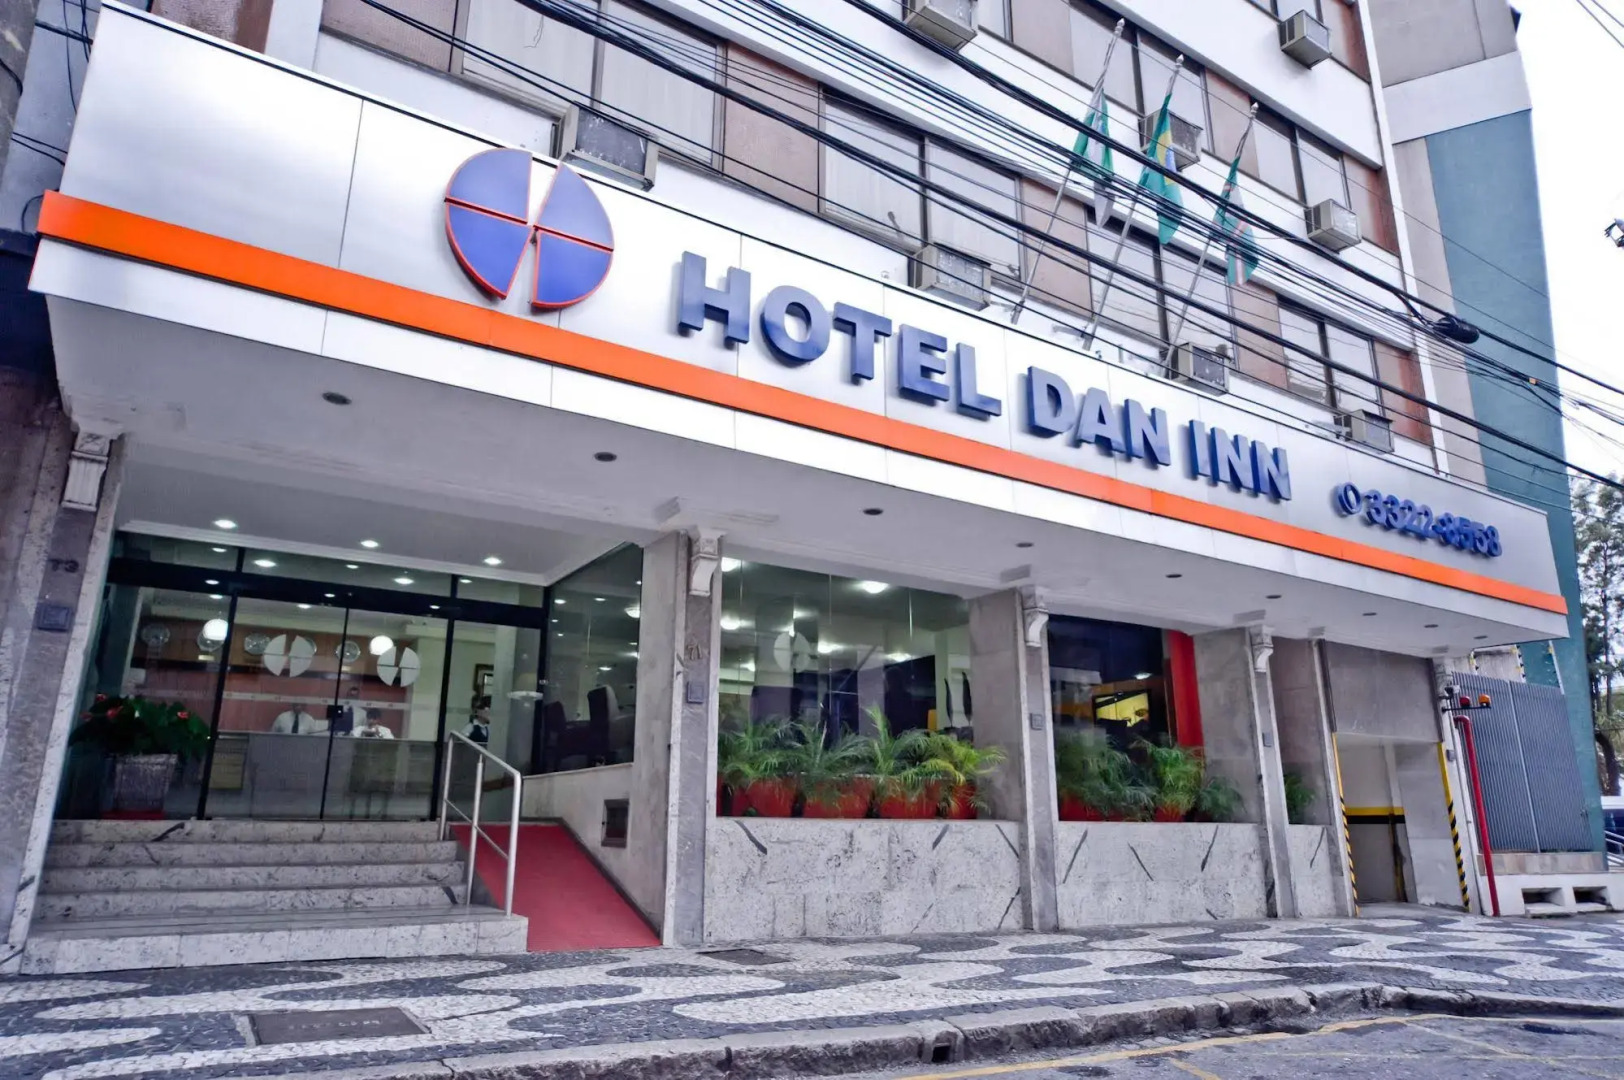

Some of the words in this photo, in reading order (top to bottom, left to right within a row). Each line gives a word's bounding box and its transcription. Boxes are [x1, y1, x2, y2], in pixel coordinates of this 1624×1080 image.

[678, 250, 1002, 416] HOTEL
[1026, 365, 1171, 466] DAN
[1189, 419, 1292, 500] INN
